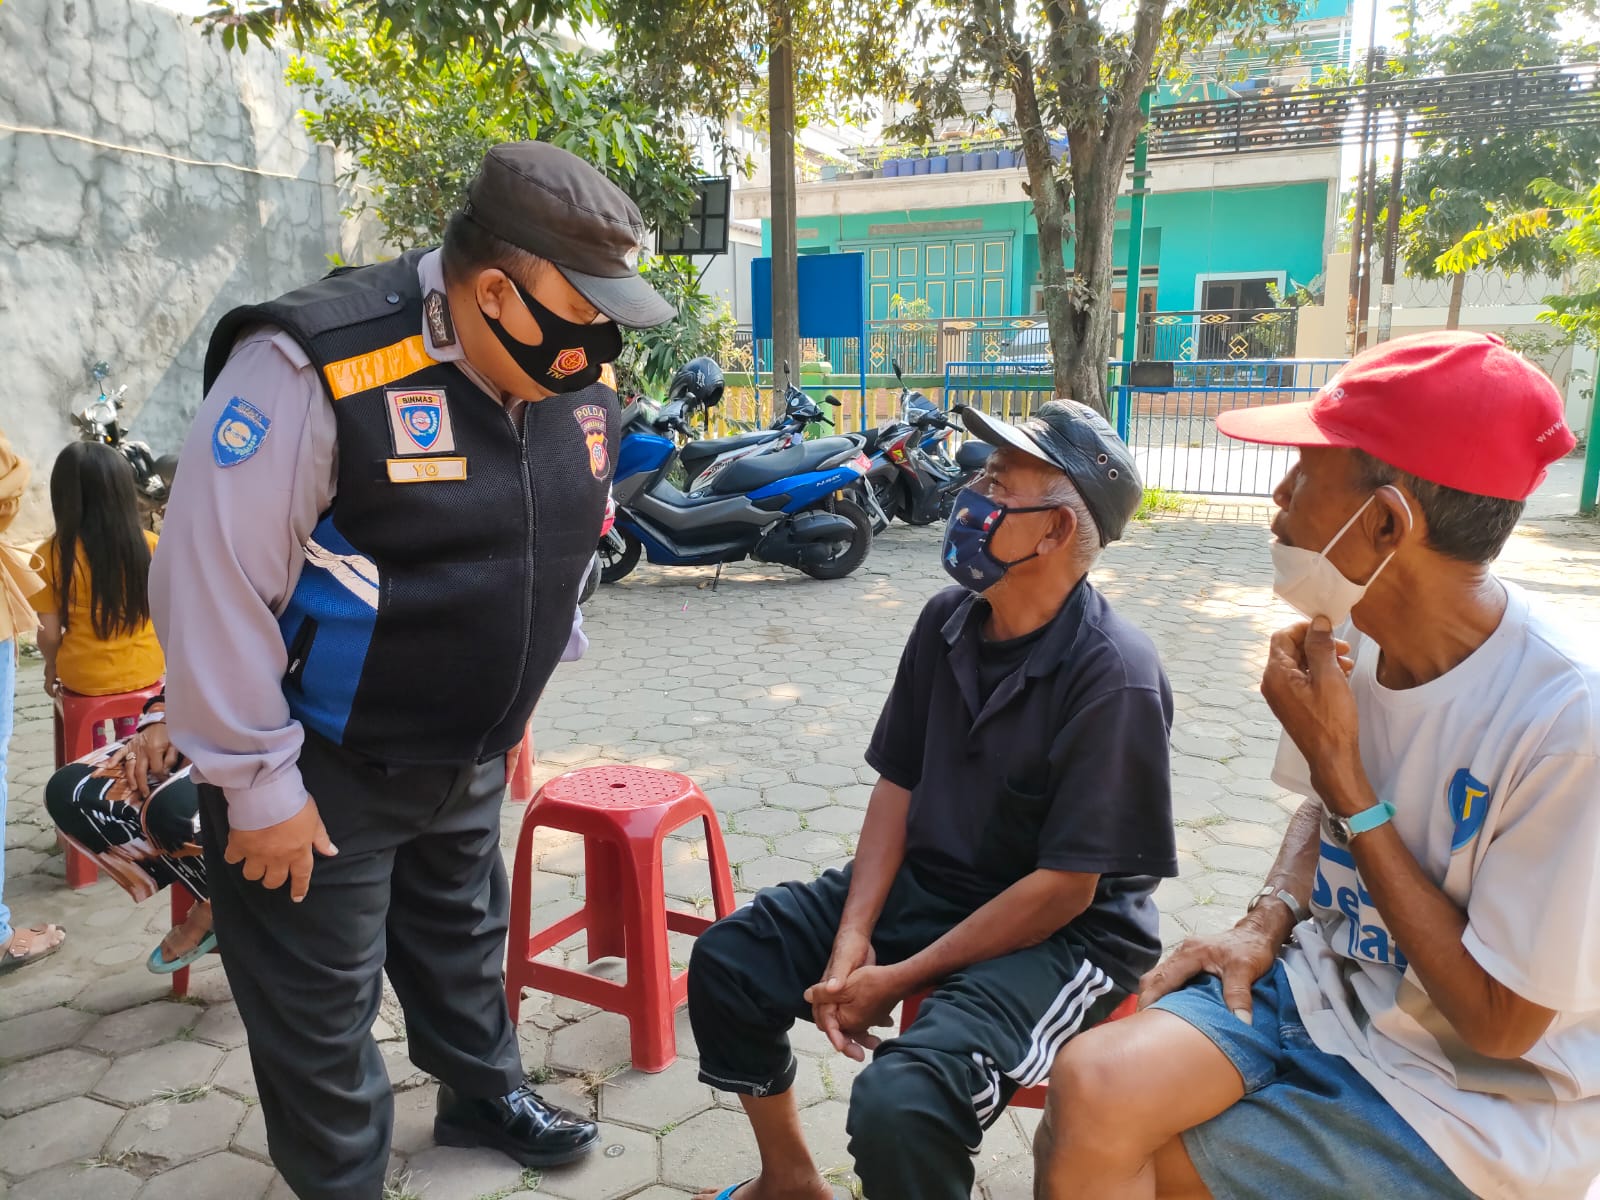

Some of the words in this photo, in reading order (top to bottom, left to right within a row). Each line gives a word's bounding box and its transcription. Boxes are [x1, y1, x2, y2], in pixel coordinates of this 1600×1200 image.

[545, 367, 567, 380] TNI
[402, 395, 433, 404] BINMAS
[576, 406, 605, 420] POLDA
[413, 463, 440, 477] YO
